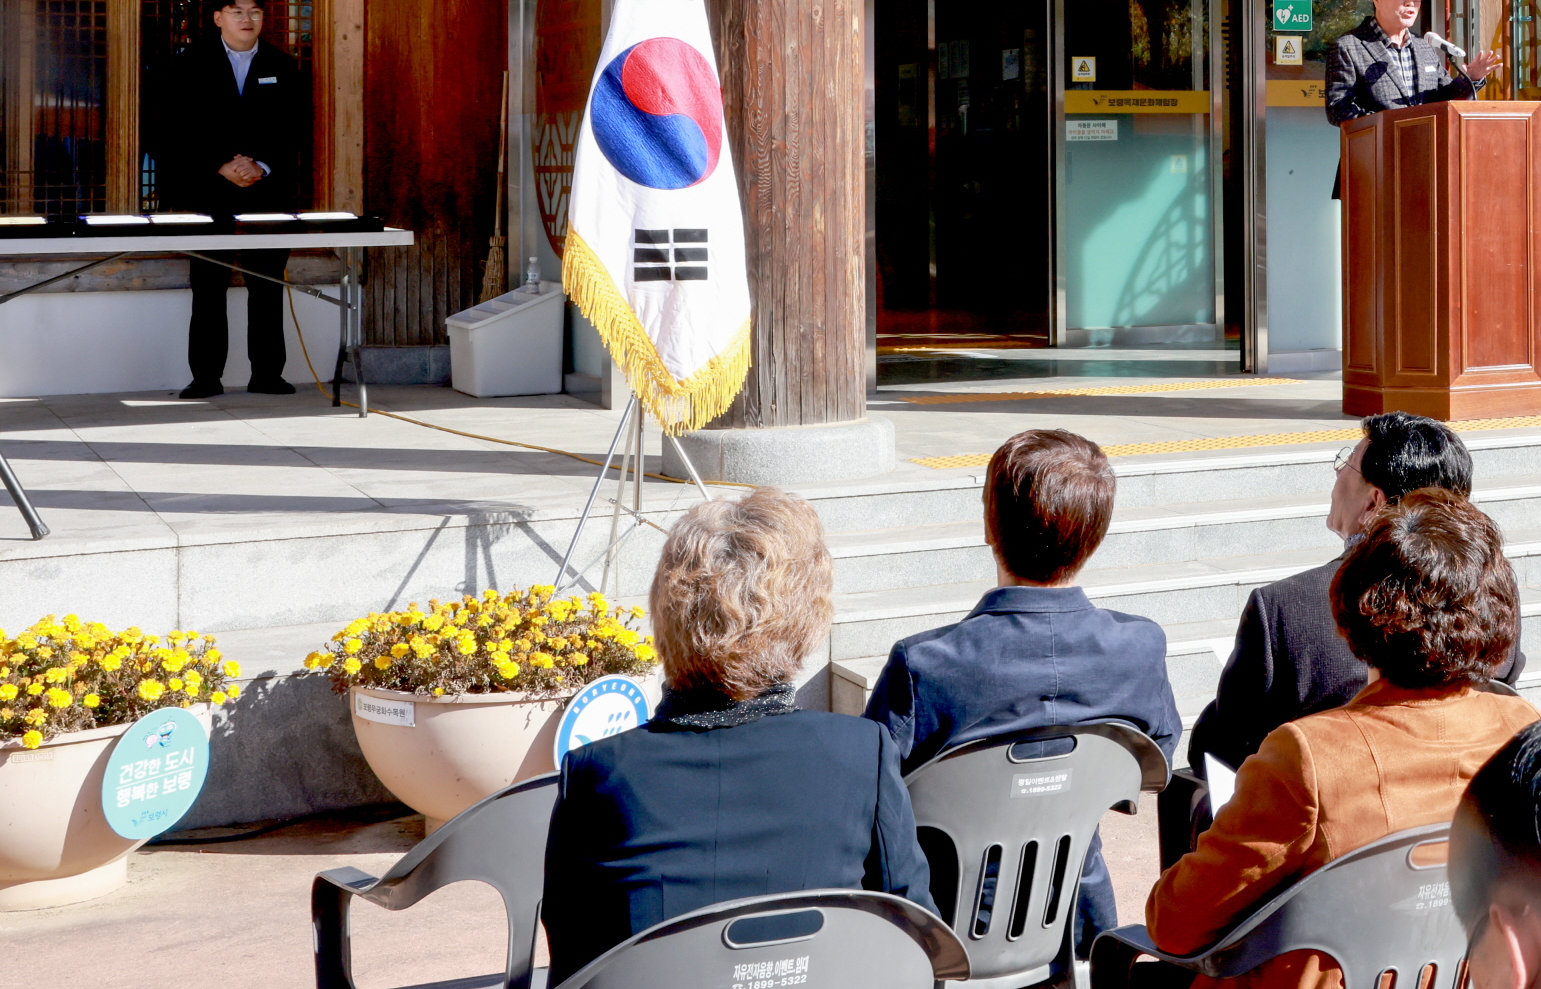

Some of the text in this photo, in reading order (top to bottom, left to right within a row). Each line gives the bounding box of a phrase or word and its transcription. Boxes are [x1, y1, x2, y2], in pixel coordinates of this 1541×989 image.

[1291, 14, 1310, 23] AED
[573, 682, 641, 714] BORYEONG
[119, 746, 195, 785] 건강한 도시
[116, 769, 192, 808] 행복한 보령
[148, 809, 168, 822] 보령시
